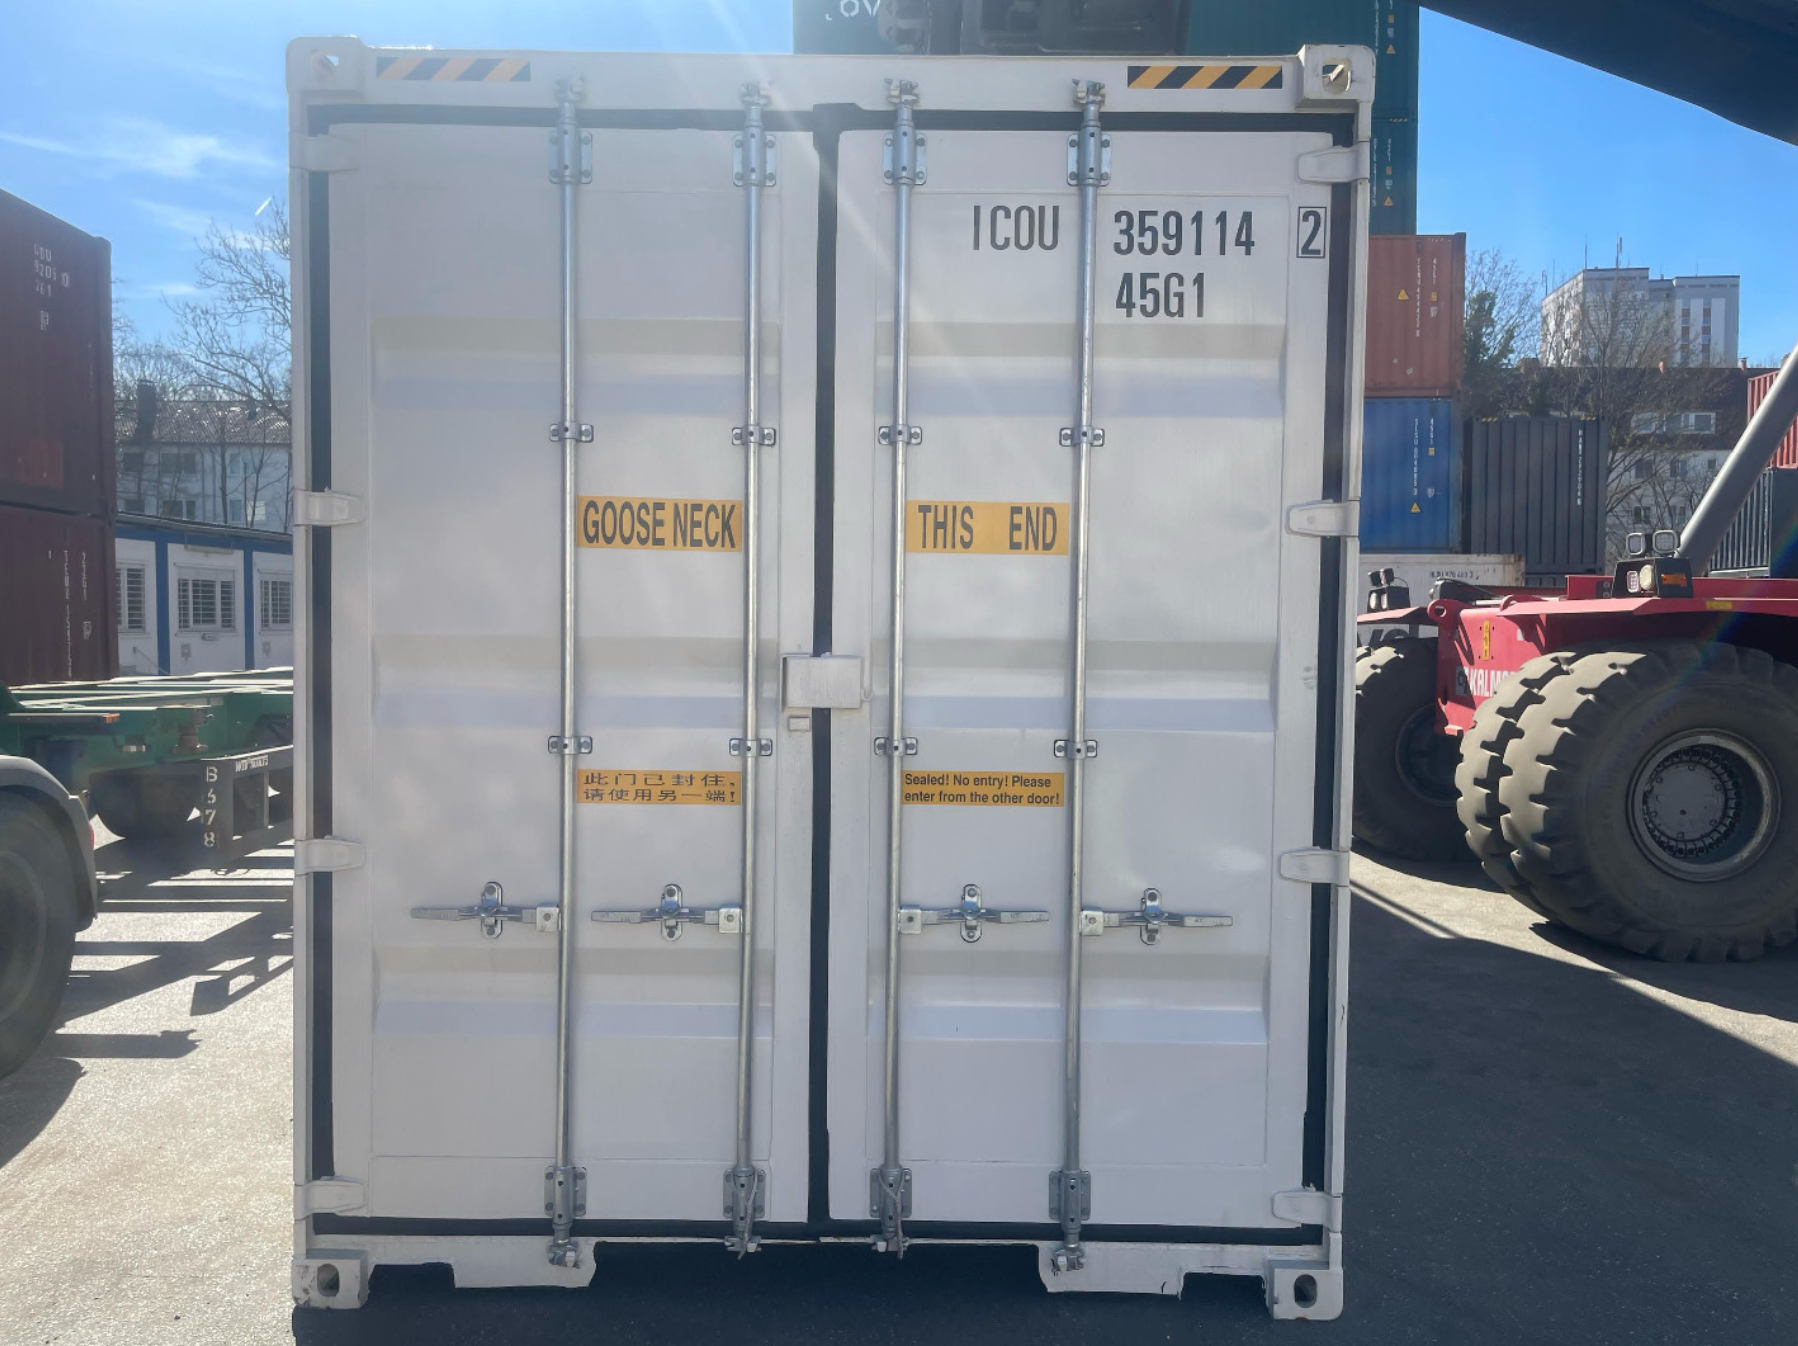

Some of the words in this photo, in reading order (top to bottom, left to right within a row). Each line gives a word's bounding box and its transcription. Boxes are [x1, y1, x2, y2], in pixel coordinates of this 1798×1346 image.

[973, 205, 1060, 251] ICOU
[1113, 210, 1256, 256] 359114
[1300, 210, 1322, 256] 2
[1115, 272, 1205, 318] 45G1
[582, 500, 666, 546] GOOSE
[673, 503, 737, 548] NECK
[917, 504, 974, 549] THIS
[1008, 506, 1058, 551] END
[1470, 668, 1518, 698] KALM
[904, 791, 935, 802] enter
[938, 790, 966, 803] from
[969, 791, 989, 803] the
[992, 792, 1023, 804] other
[1026, 793, 1060, 805] door!
[905, 773, 950, 786] Sealed!
[953, 775, 970, 786] No
[973, 775, 1008, 789] entry!
[1011, 775, 1051, 788] Please
